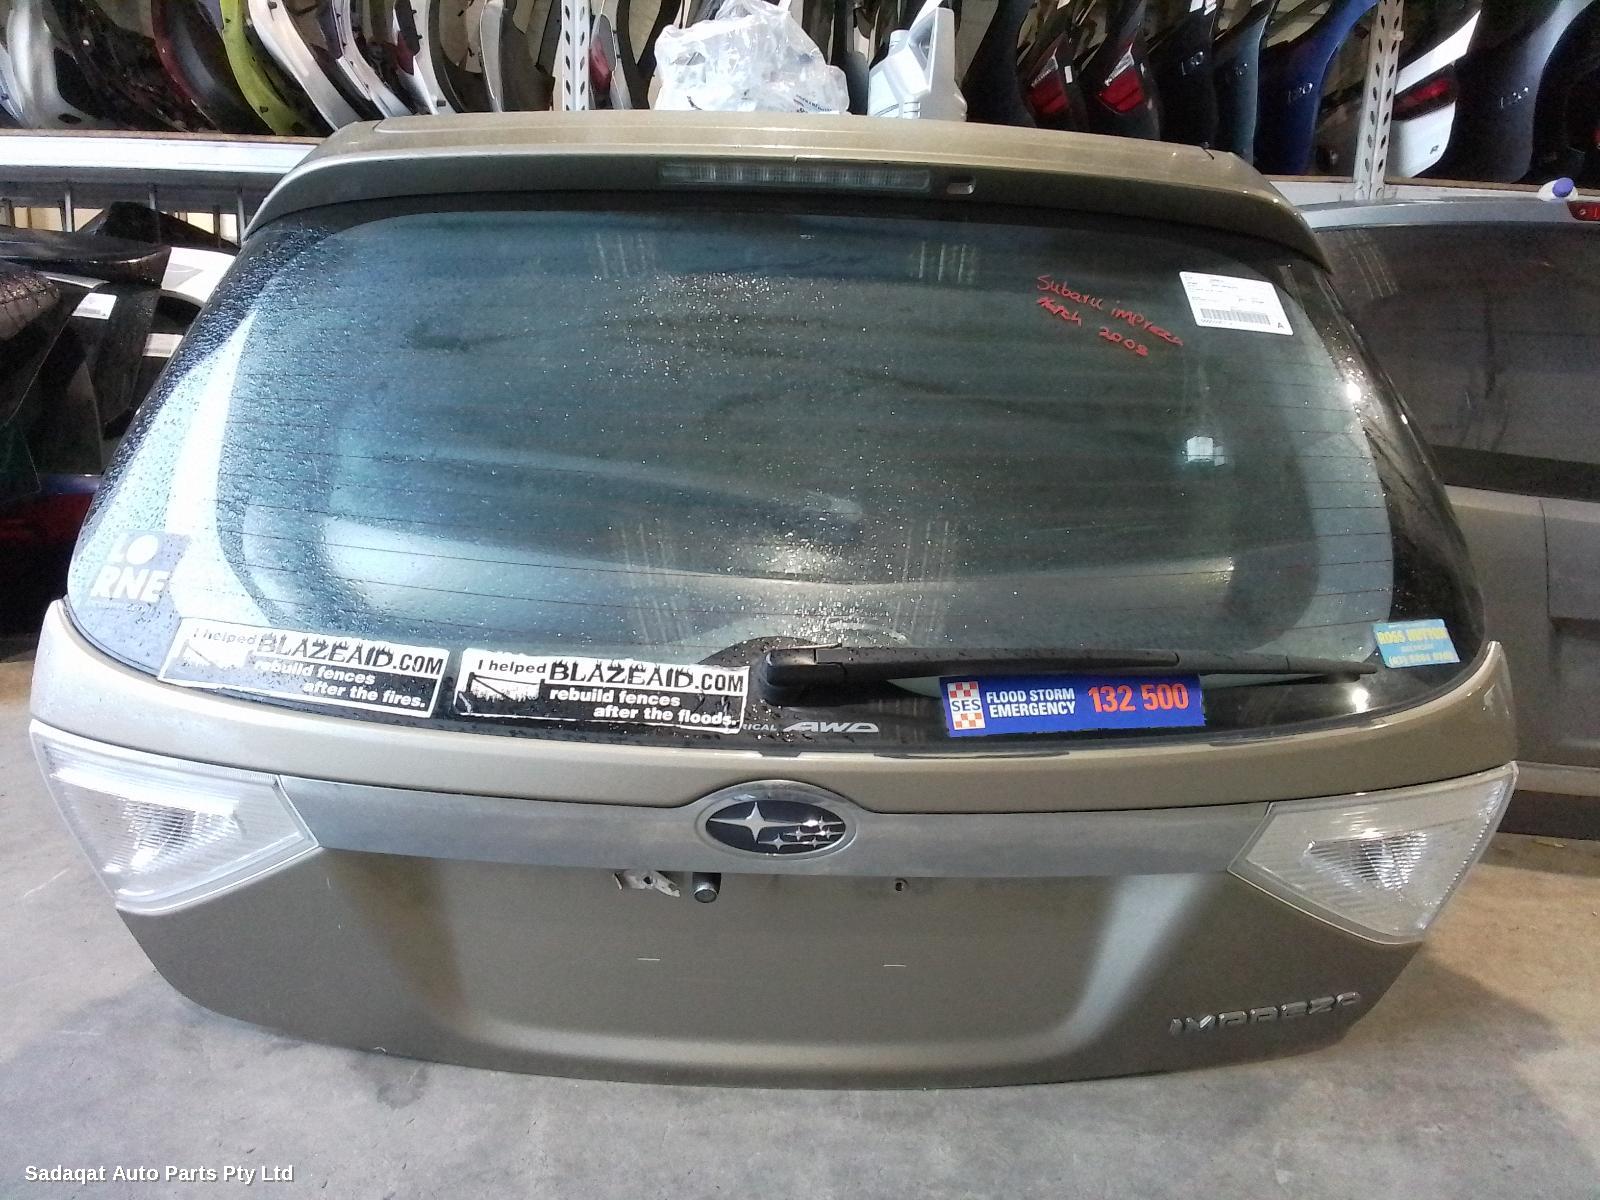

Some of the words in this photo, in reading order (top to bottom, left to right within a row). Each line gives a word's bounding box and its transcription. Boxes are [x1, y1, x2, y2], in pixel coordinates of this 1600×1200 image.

[203, 628, 257, 644] helped
[257, 632, 444, 675] BLAZEAID.COM
[254, 660, 315, 678] rebuild
[316, 664, 376, 685] fences
[478, 659, 483, 670] I
[488, 660, 547, 674] helped
[549, 659, 744, 693] BLAZEAID.COM
[302, 680, 346, 697] after
[349, 684, 379, 701] the
[382, 689, 426, 708] fires.
[549, 687, 615, 703] rebuild
[619, 690, 681, 707] fences
[951, 699, 981, 712] SES
[986, 690, 1027, 704] FLOOD
[1029, 687, 1075, 702] STORM
[1088, 684, 1136, 712] 132
[1141, 683, 1189, 710] 500
[593, 704, 639, 719] after
[643, 707, 674, 720] the
[678, 708, 739, 727] floods.
[989, 700, 1076, 718] EMERGENCY
[782, 721, 879, 733] AWD
